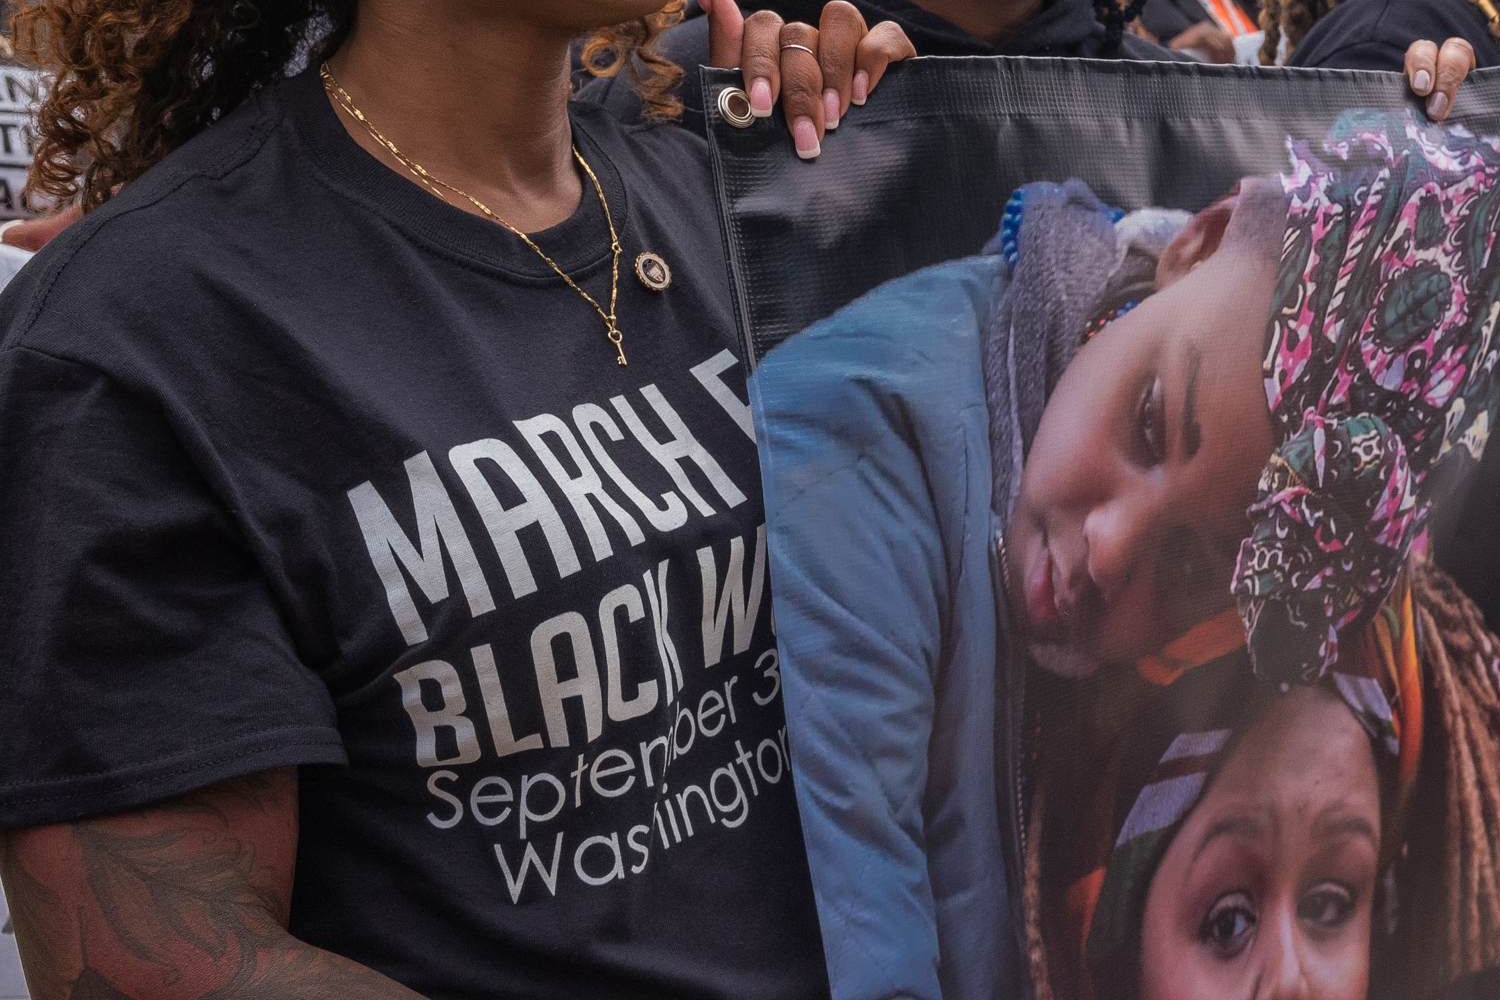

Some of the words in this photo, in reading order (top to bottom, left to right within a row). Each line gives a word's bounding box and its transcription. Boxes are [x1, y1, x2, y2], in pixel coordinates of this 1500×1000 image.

[346, 383, 748, 647] MARCH
[393, 558, 687, 769] BLACK
[696, 522, 779, 668] W
[426, 674, 739, 840] September
